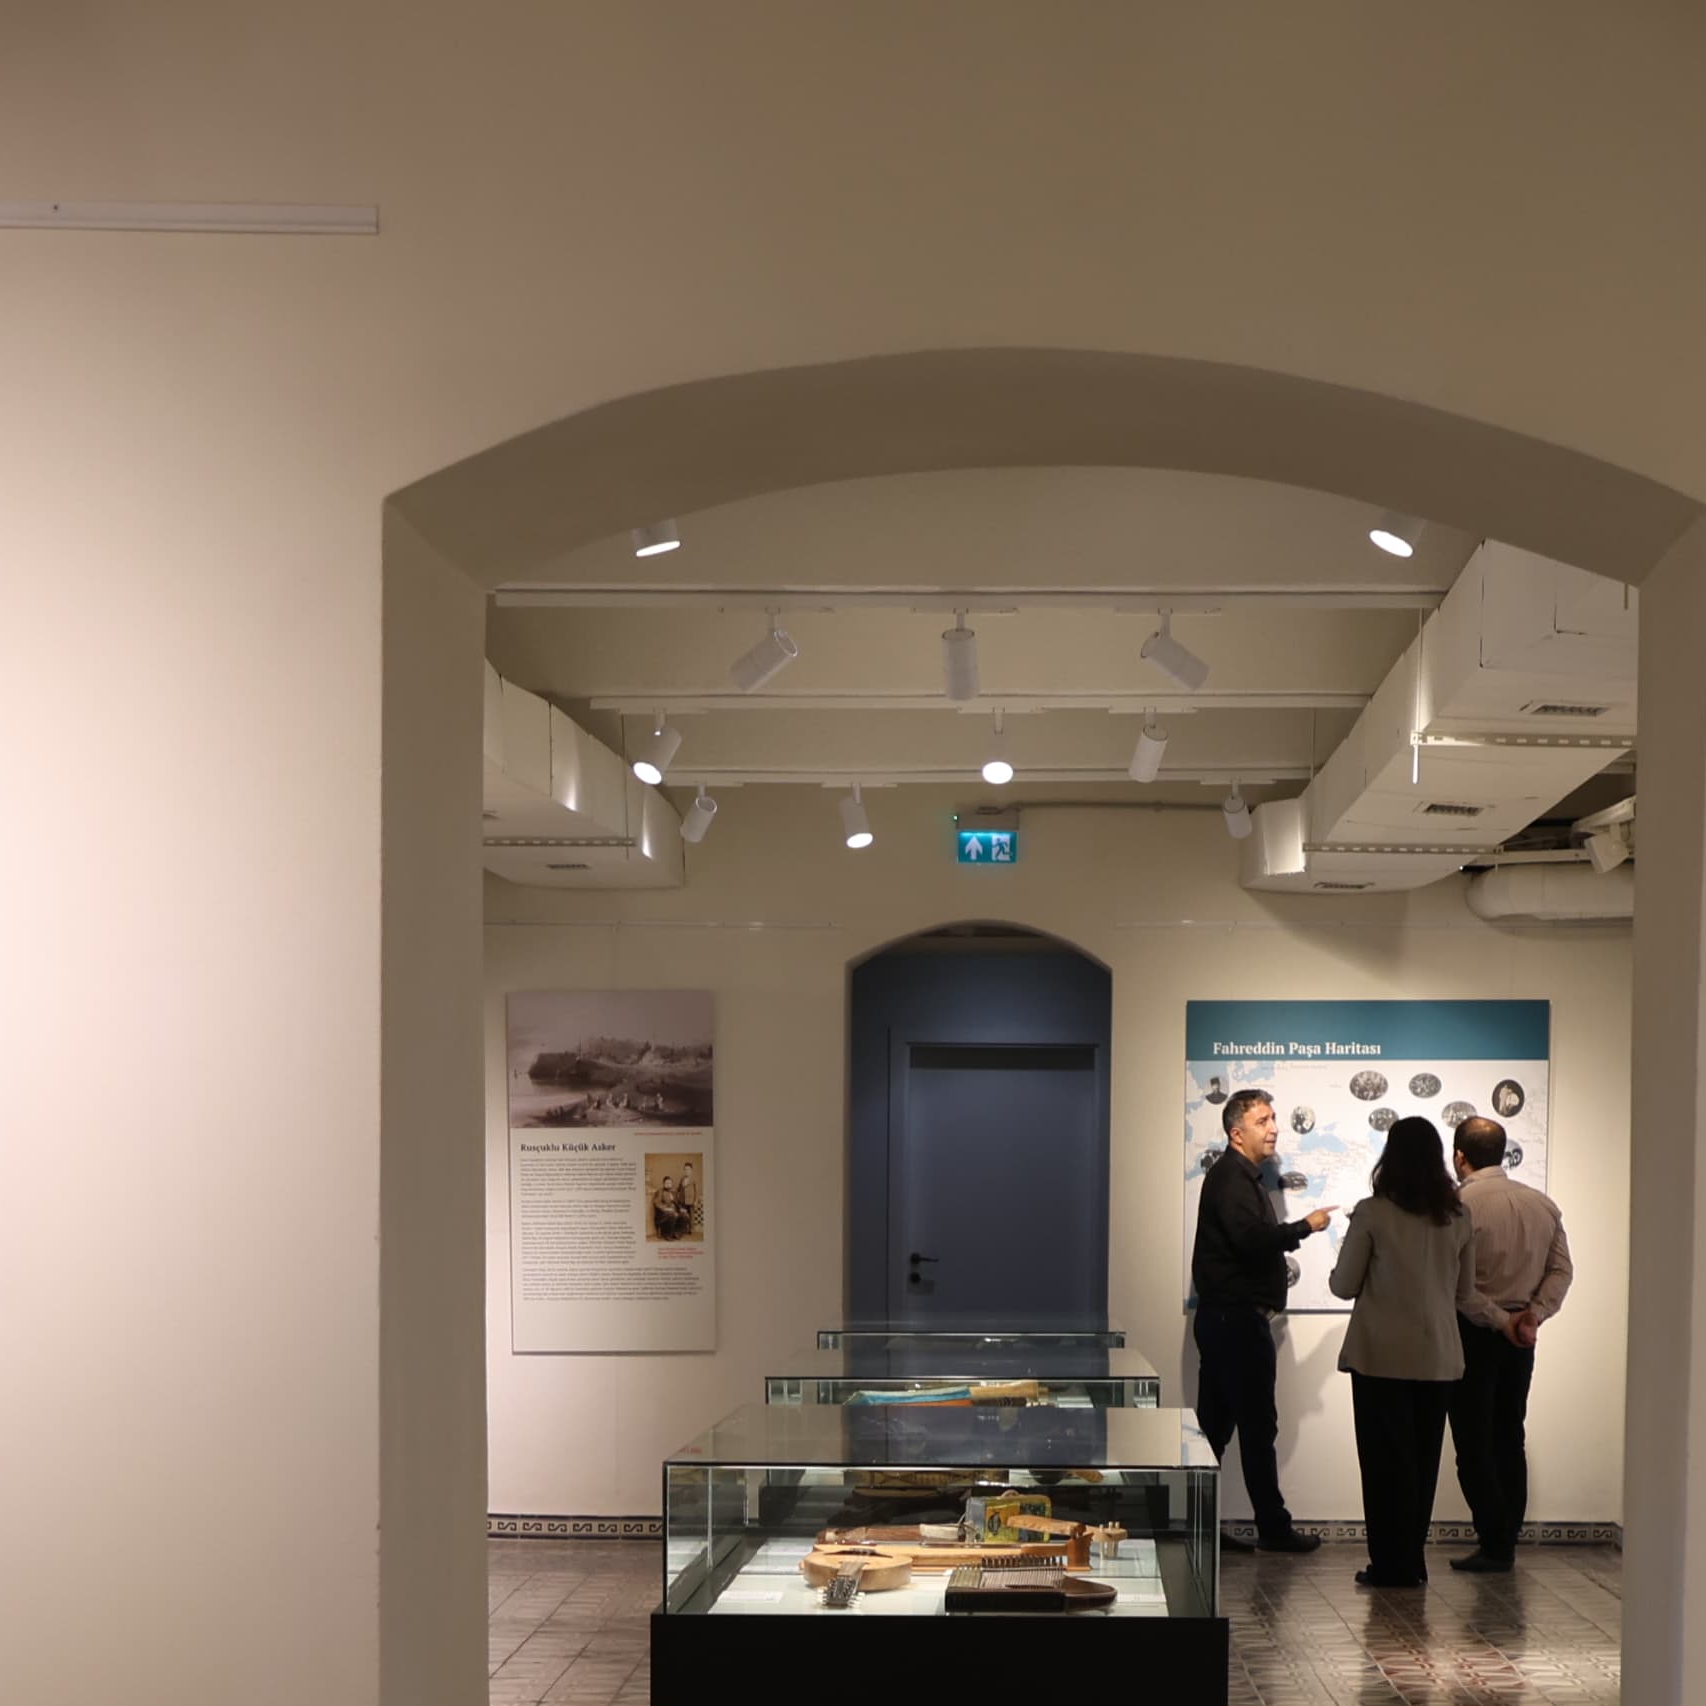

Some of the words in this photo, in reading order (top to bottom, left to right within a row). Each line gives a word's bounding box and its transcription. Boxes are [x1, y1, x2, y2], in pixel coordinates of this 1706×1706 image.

[1213, 1041, 1285, 1054] Fahreddin
[1288, 1042, 1321, 1058] Paşa
[1325, 1041, 1381, 1054] Haritası
[521, 1143, 560, 1154] Rusçuklu
[562, 1142, 588, 1154] Küçük
